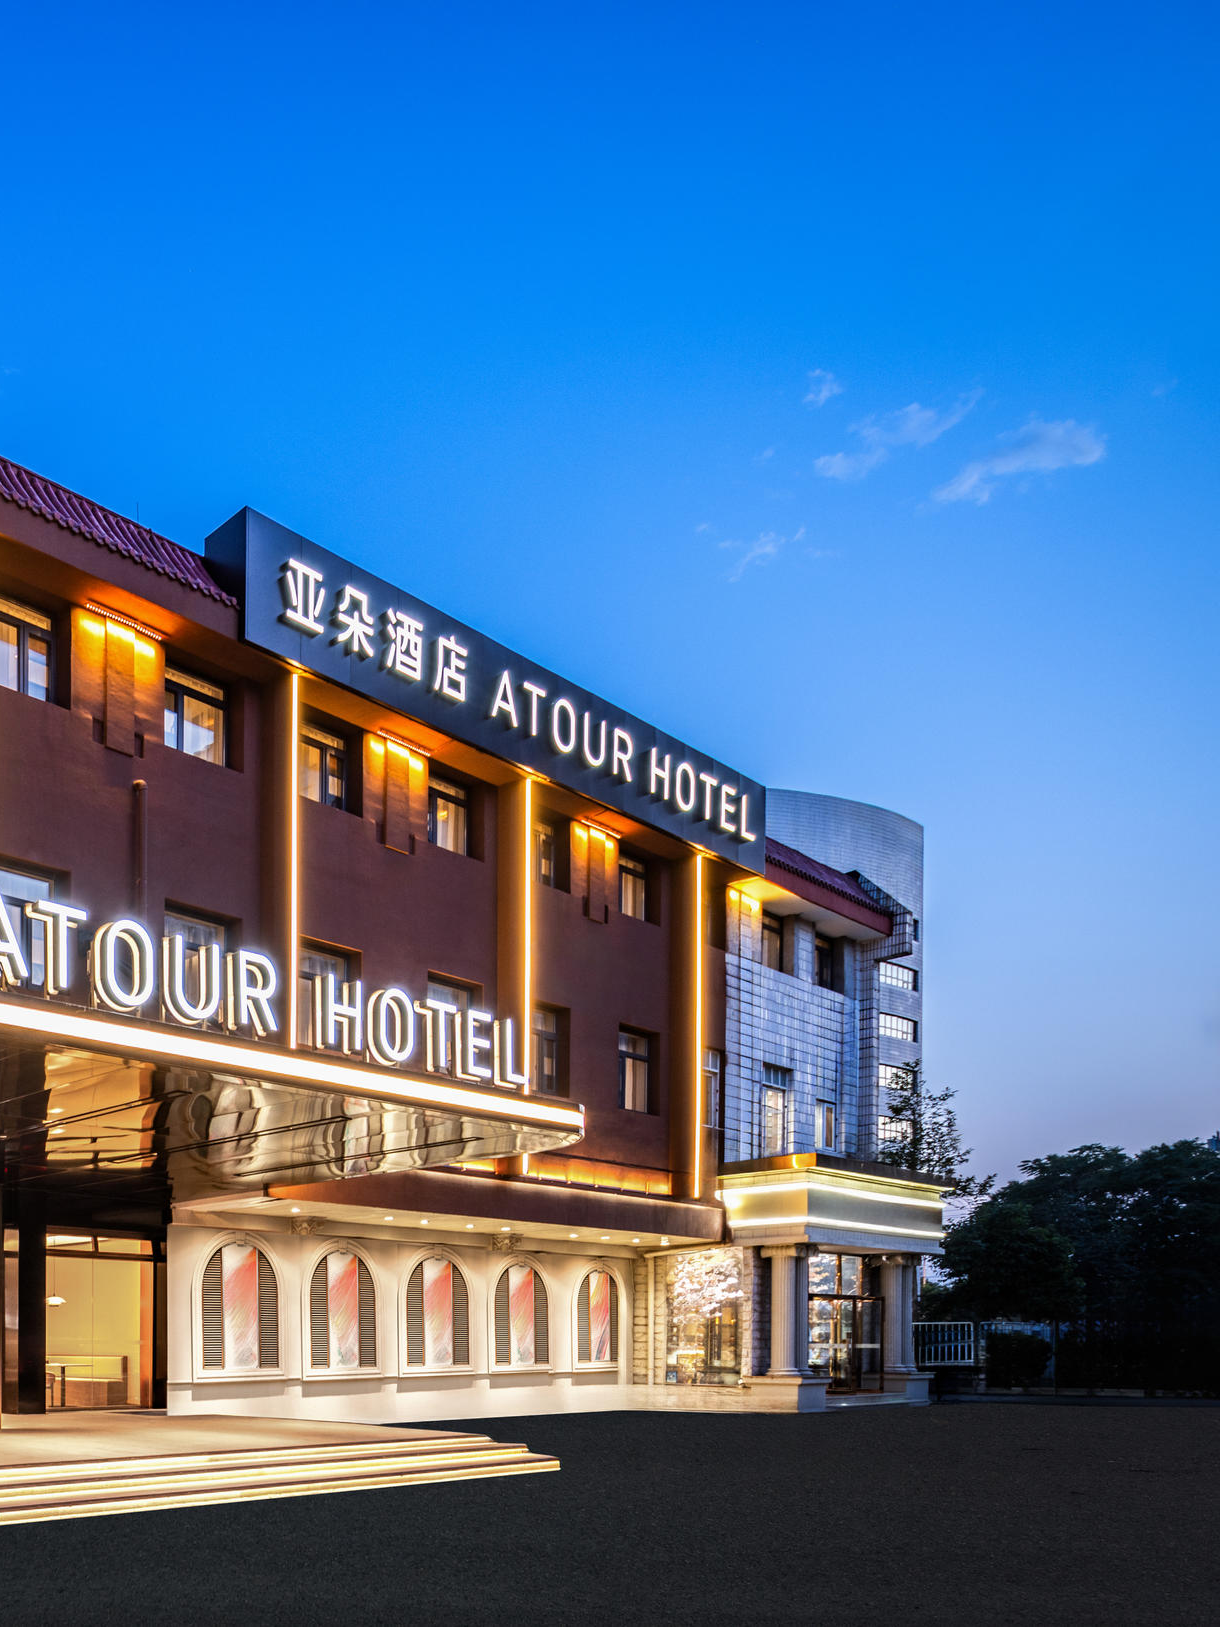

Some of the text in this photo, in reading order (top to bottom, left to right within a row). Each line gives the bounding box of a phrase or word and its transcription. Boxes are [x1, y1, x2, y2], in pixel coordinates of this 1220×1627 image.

[285, 558, 469, 702] 亚朵酒店
[491, 669, 757, 842] ATOUR HOTEL
[314, 972, 530, 1090] HOTEL
